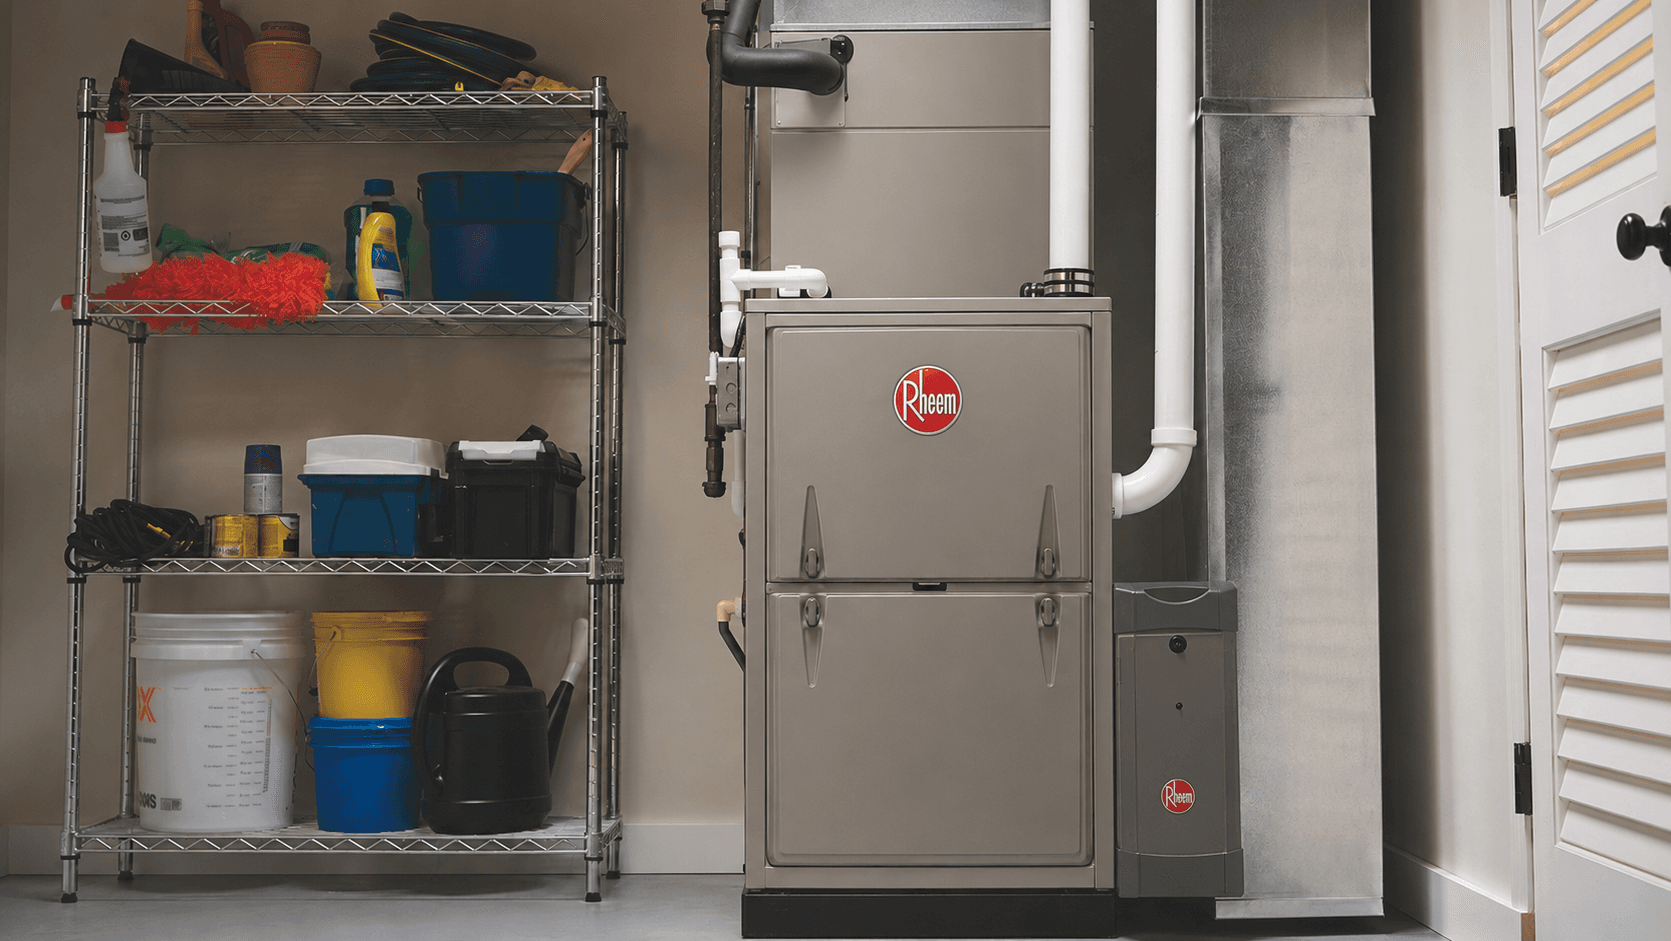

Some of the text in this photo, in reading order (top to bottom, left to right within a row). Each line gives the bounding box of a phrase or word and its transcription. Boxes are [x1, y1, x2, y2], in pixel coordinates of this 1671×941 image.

[903, 369, 957, 422] Rheem
[136, 686, 156, 723] X
[1165, 780, 1193, 808] Rheem
